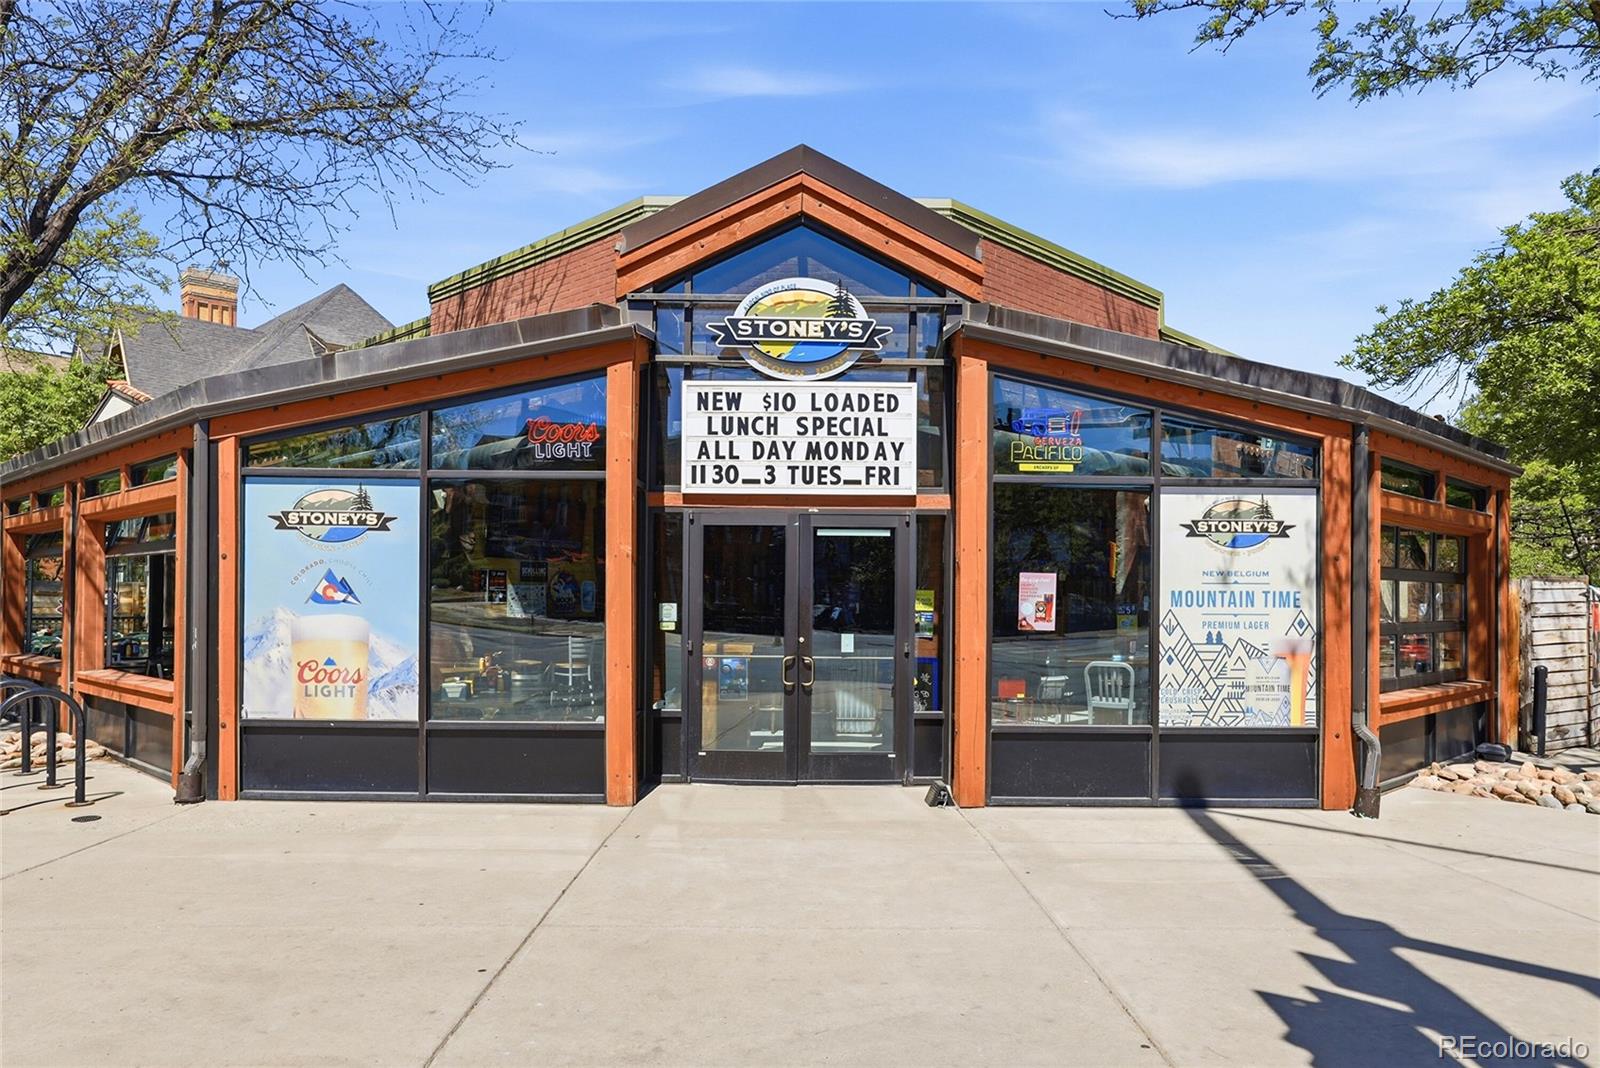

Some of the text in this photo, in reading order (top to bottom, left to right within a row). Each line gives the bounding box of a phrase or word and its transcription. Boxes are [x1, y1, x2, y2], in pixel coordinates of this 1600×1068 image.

[737, 320, 863, 338] STONEY'S
[697, 392, 899, 412] NEW $10 LOADED
[527, 416, 600, 443] Coors
[707, 416, 889, 437] LUNCH SPECIAL
[1034, 436, 1082, 446] CERVEZA
[535, 442, 592, 459] LIGHT
[697, 440, 905, 461] ALL DAY MONDAY
[287, 512, 378, 526] STONEY'S
[1197, 521, 1279, 532] STONEY'S
[1170, 590, 1301, 609] MOUNTAIN TIME
[1202, 621, 1270, 630] PREMIUM LAGER
[297, 659, 363, 684] Coors
[304, 685, 356, 698] LIGHT
